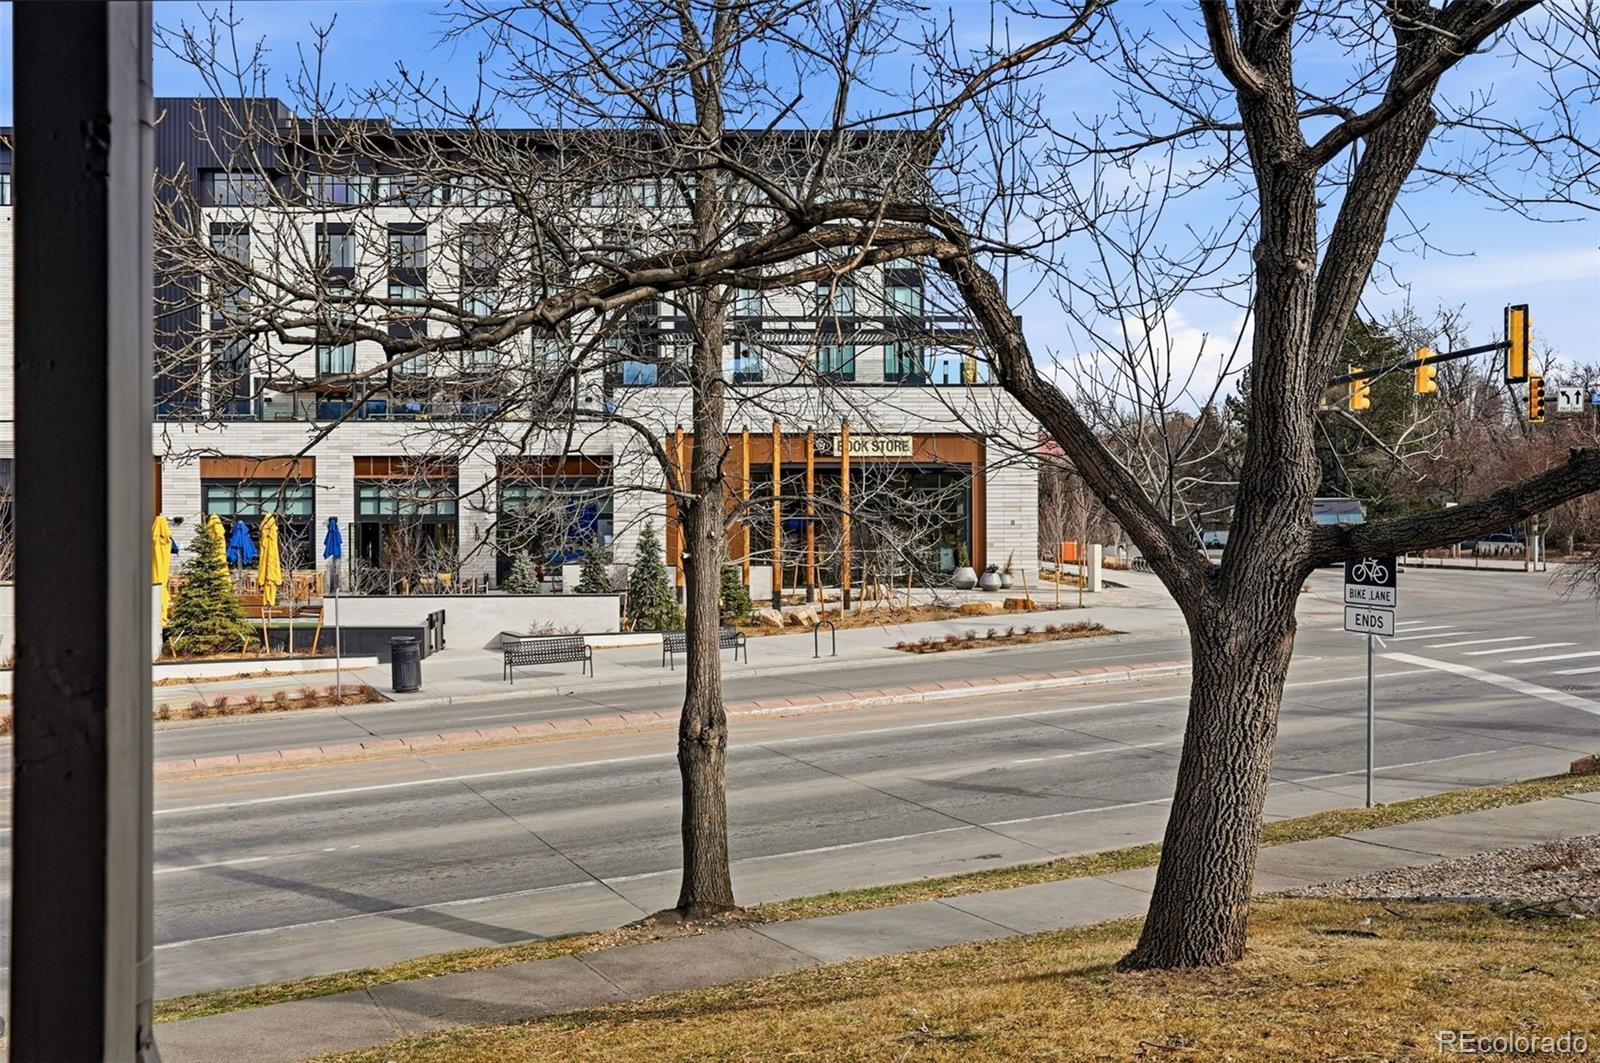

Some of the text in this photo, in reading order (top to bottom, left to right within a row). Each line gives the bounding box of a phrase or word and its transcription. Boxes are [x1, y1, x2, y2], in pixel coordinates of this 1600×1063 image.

[871, 439, 911, 452] STORE
[1349, 588, 1391, 602] BIKE LANE
[1355, 613, 1384, 629] ENDS
